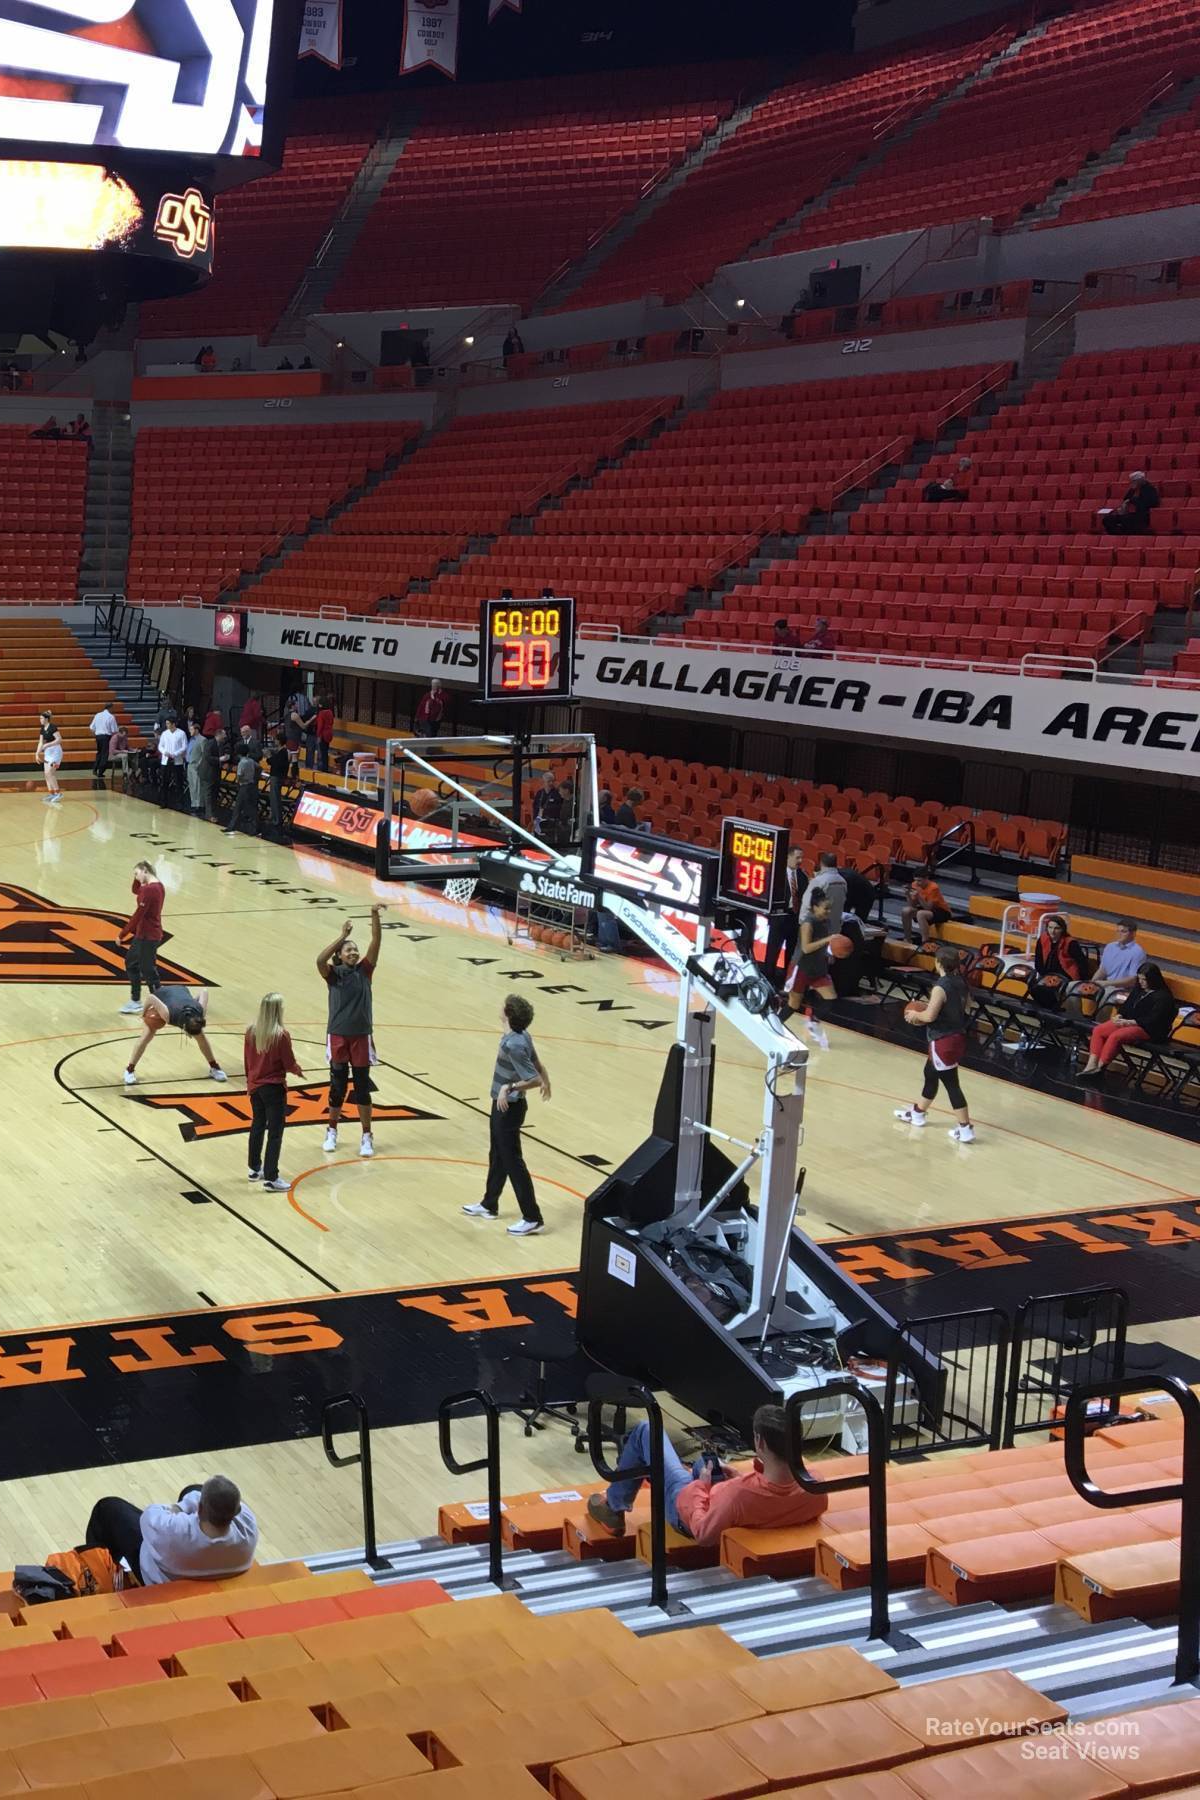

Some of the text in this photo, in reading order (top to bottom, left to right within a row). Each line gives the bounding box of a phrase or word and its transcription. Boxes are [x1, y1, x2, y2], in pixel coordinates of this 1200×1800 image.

[303, 6, 324, 17] 983
[155, 190, 210, 254] OSU
[842, 338, 873, 354] 212
[263, 399, 293, 409] 210
[493, 609, 561, 638] 60:00
[502, 639, 551, 688] 30
[774, 656, 801, 671] 108
[280, 628, 367, 654] WELCOME
[371, 636, 400, 657] TO
[1041, 702, 1200, 753] ARE
[299, 796, 340, 822] TATE
[337, 806, 375, 834] OSU
[732, 831, 774, 864] 60:00
[738, 860, 766, 895] 30
[457, 956, 675, 1031] ARENA
